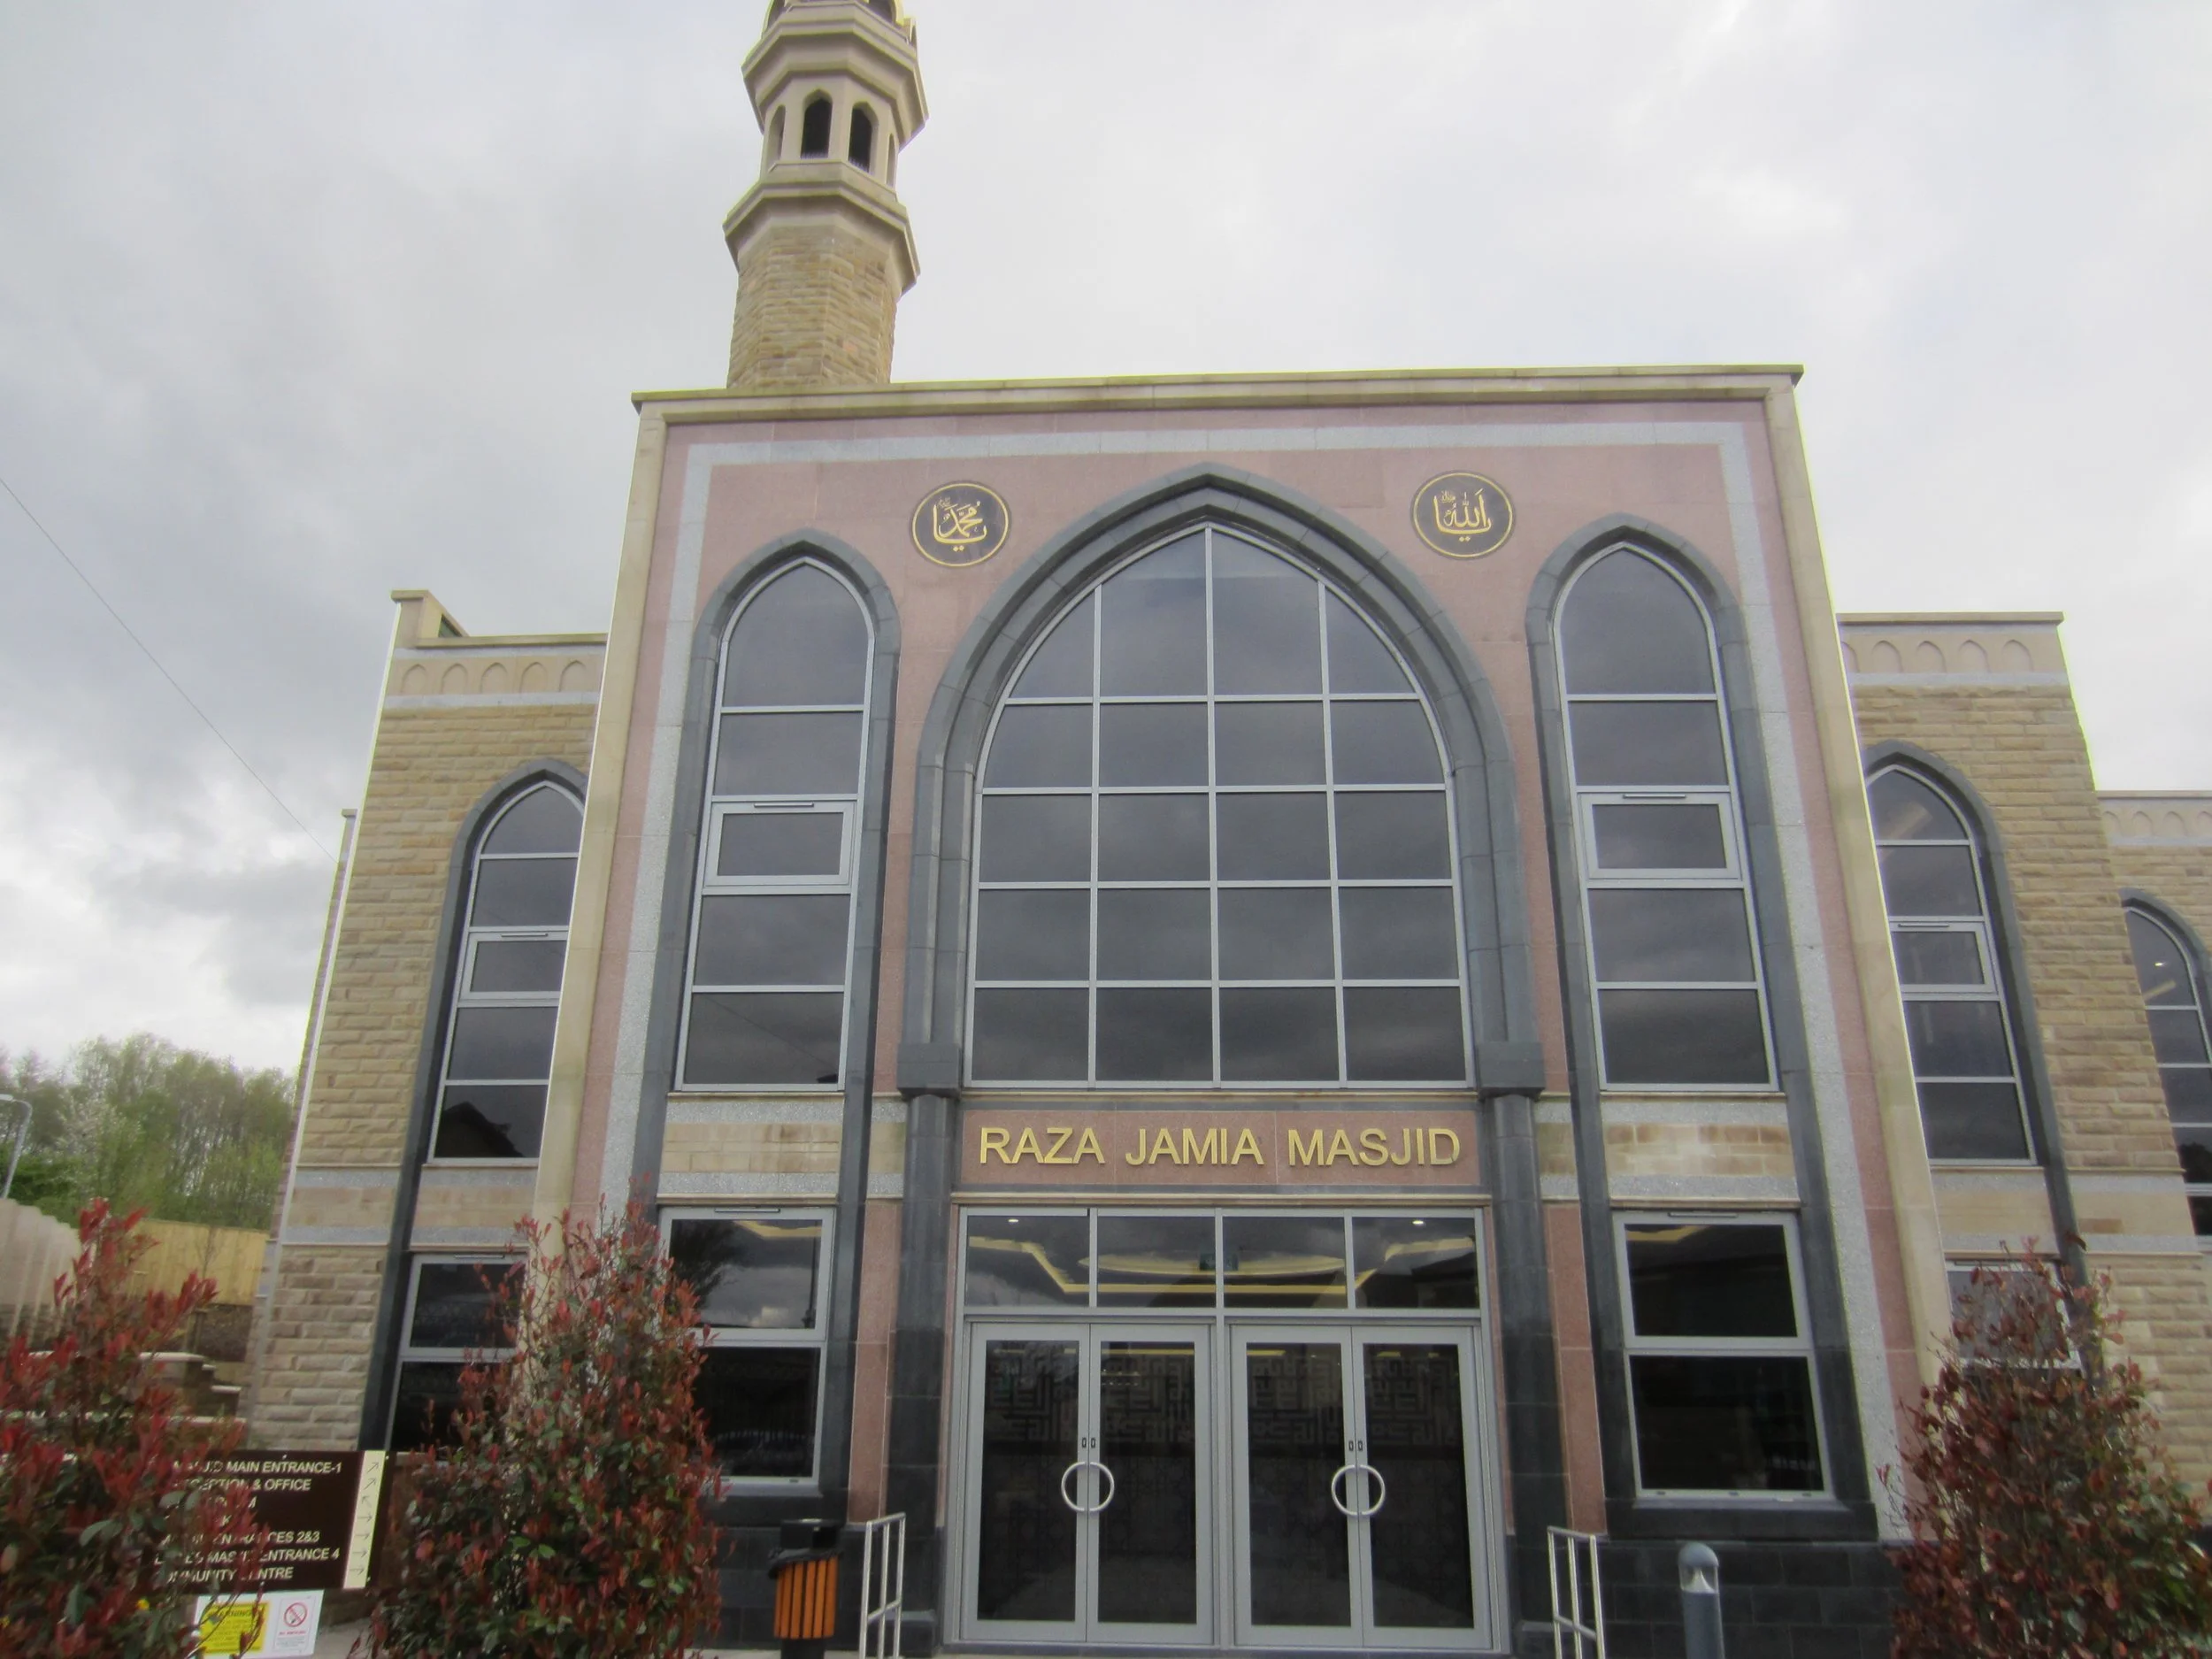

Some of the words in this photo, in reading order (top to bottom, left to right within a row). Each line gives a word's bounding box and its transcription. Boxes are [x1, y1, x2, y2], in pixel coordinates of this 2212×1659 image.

[979, 1126, 1106, 1165] RAZA
[1125, 1127, 1264, 1166] JAMIA
[1288, 1128, 1462, 1167] MASJID
[226, 1461, 260, 1473] MAIN
[172, 1478, 249, 1491] CEPTIO
[252, 1478, 262, 1491] &
[264, 1479, 312, 1491] OFFICE
[296, 1530, 320, 1543] 2&3
[258, 1548, 330, 1563] ENTRANCE
[332, 1547, 341, 1560] 4
[241, 1566, 295, 1581] NTRE
